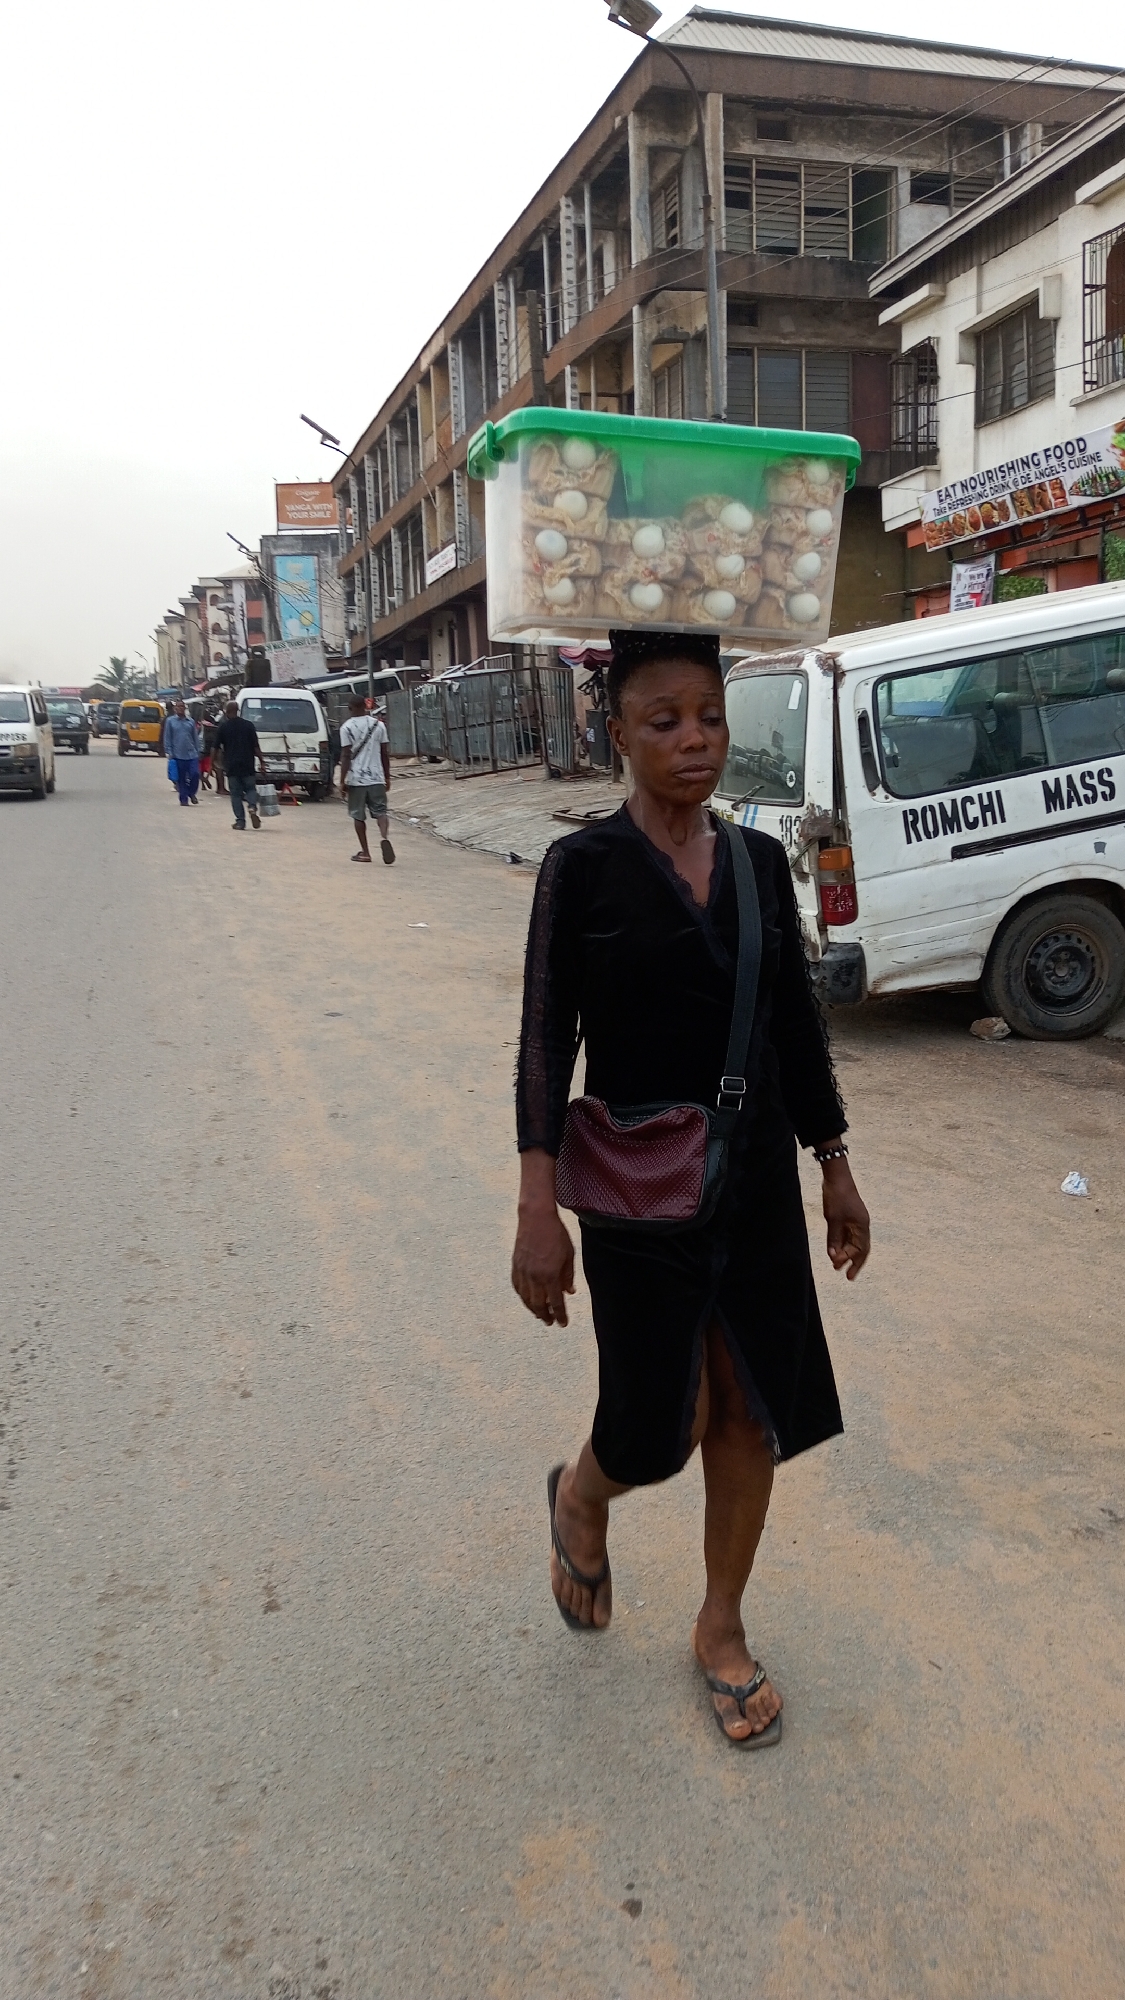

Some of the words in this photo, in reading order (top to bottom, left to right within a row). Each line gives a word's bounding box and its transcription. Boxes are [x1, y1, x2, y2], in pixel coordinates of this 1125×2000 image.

[932, 506, 947, 517] Take
[947, 488, 989, 510] REFRESHING
[989, 480, 1012, 496] DRINK
[1020, 472, 1033, 485] DE
[1034, 460, 1067, 480] ANGEL'S
[1068, 451, 1103, 470] CUISINE
[937, 484, 957, 503] EAT
[960, 453, 1041, 494] NOURISHING
[1043, 436, 1087, 464] FOOD
[285, 503, 311, 511] YANGA
[312, 503, 332, 511] WITH
[287, 511, 308, 519] YOUR
[902, 789, 1007, 845] ROMCHI
[1041, 767, 1116, 815] MASS
